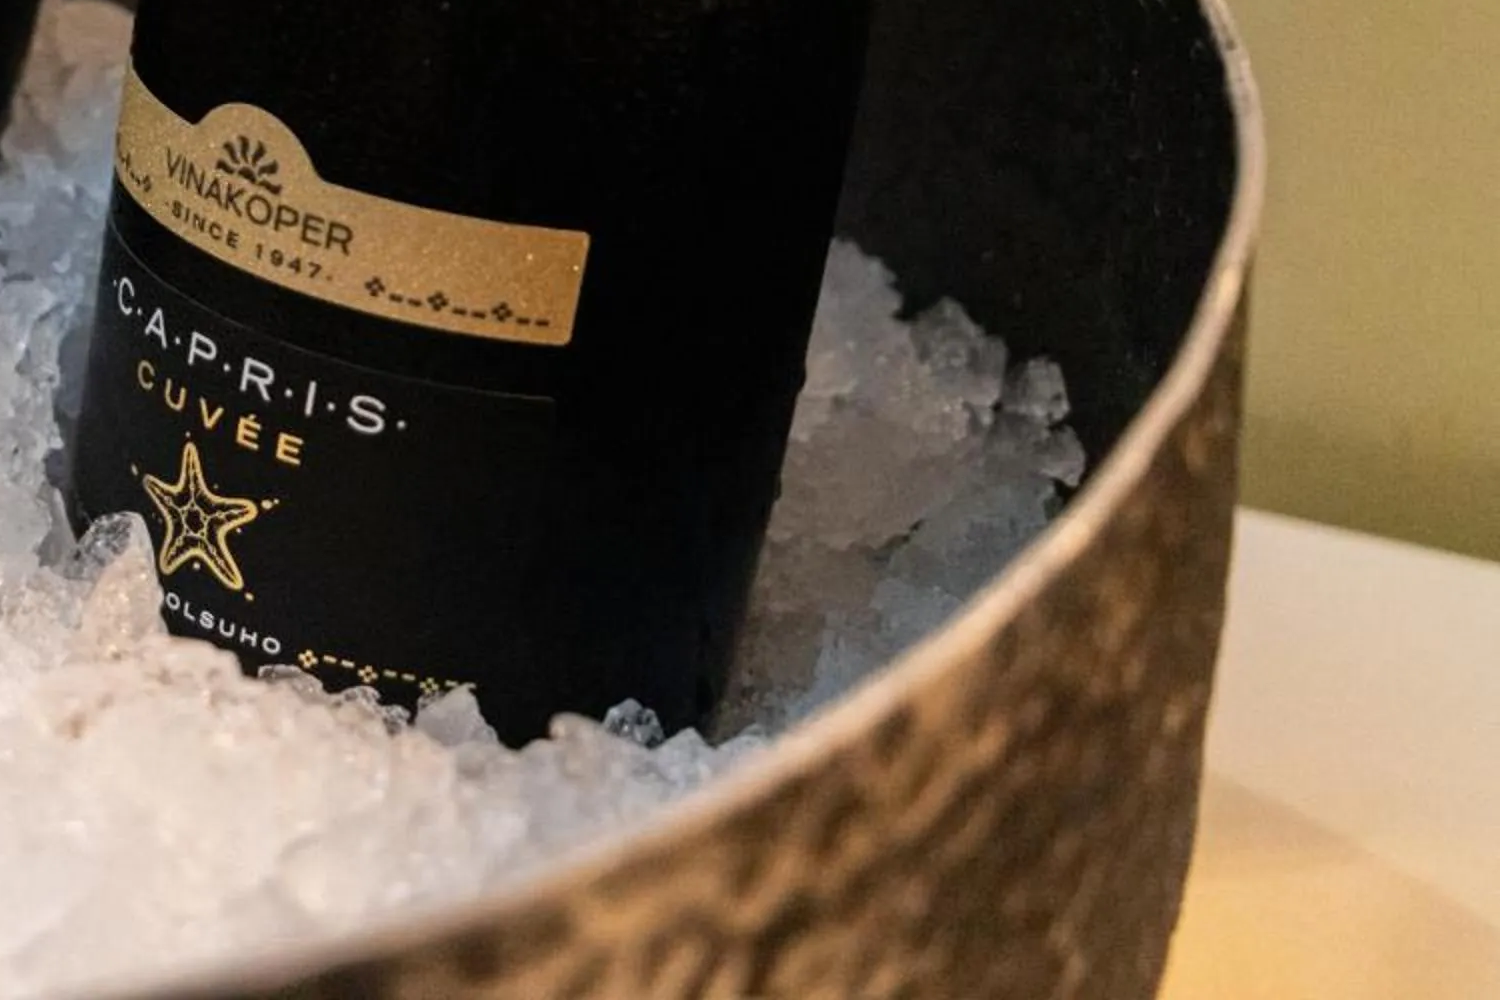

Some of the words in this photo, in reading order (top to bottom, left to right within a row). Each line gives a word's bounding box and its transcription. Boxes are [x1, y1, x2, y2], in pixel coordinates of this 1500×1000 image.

[165, 148, 354, 257] VINAKOPER
[137, 360, 304, 465] CUVÉE
[165, 592, 282, 655] OLSUHO
